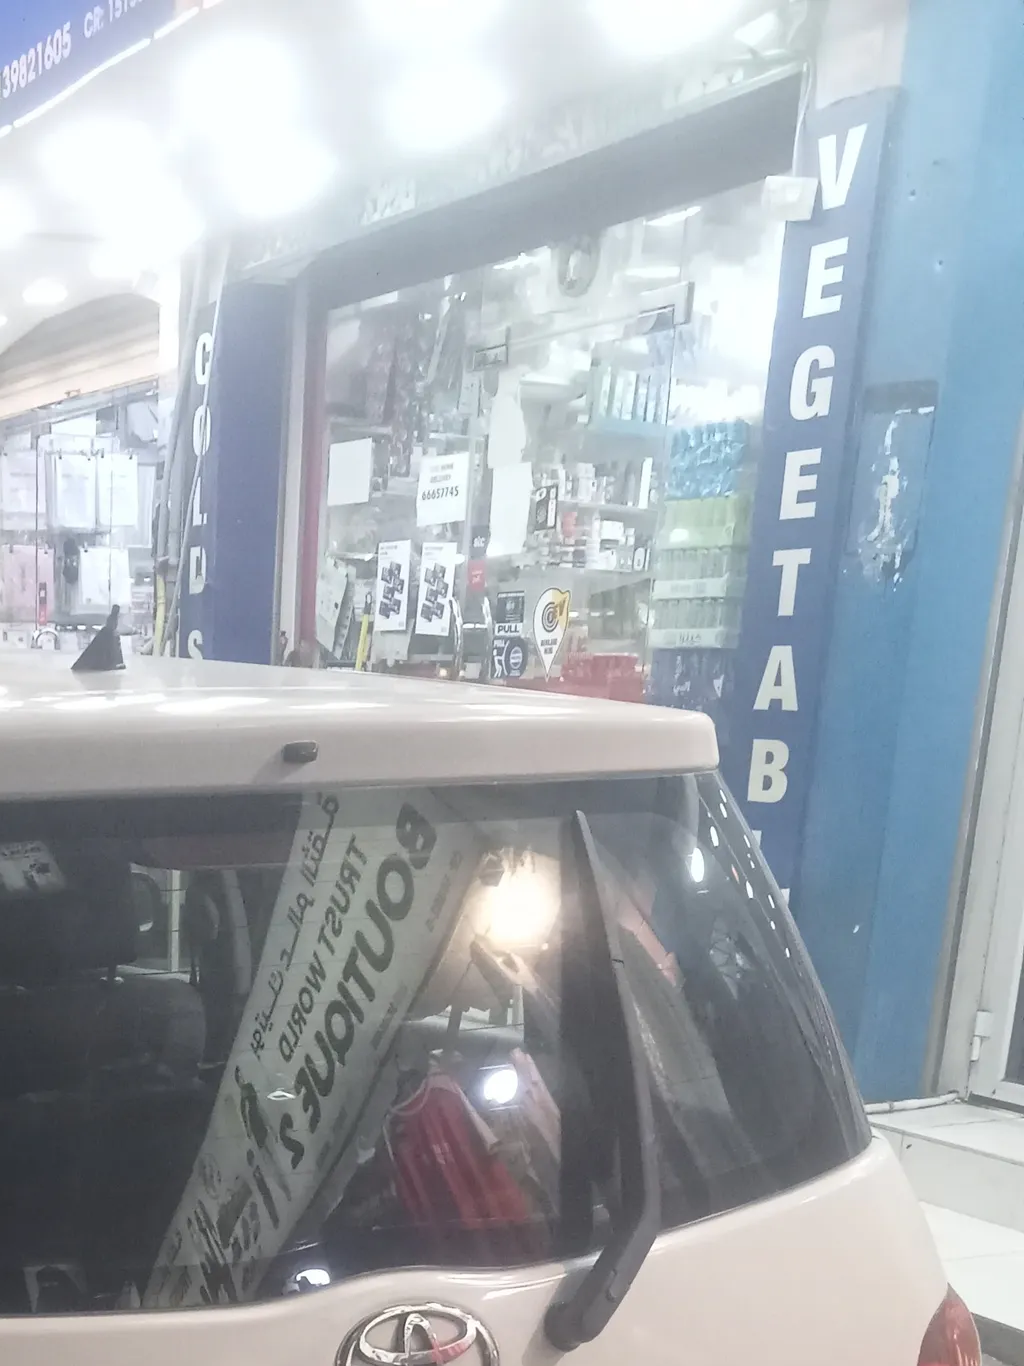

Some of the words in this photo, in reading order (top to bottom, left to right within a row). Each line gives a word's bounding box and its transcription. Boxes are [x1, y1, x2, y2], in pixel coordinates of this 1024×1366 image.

[2, 21, 73, 99] 39821605
[421, 486, 459, 501] 66657745
[747, 124, 867, 905] VEGETAB
[497, 625, 520, 634] PULL
